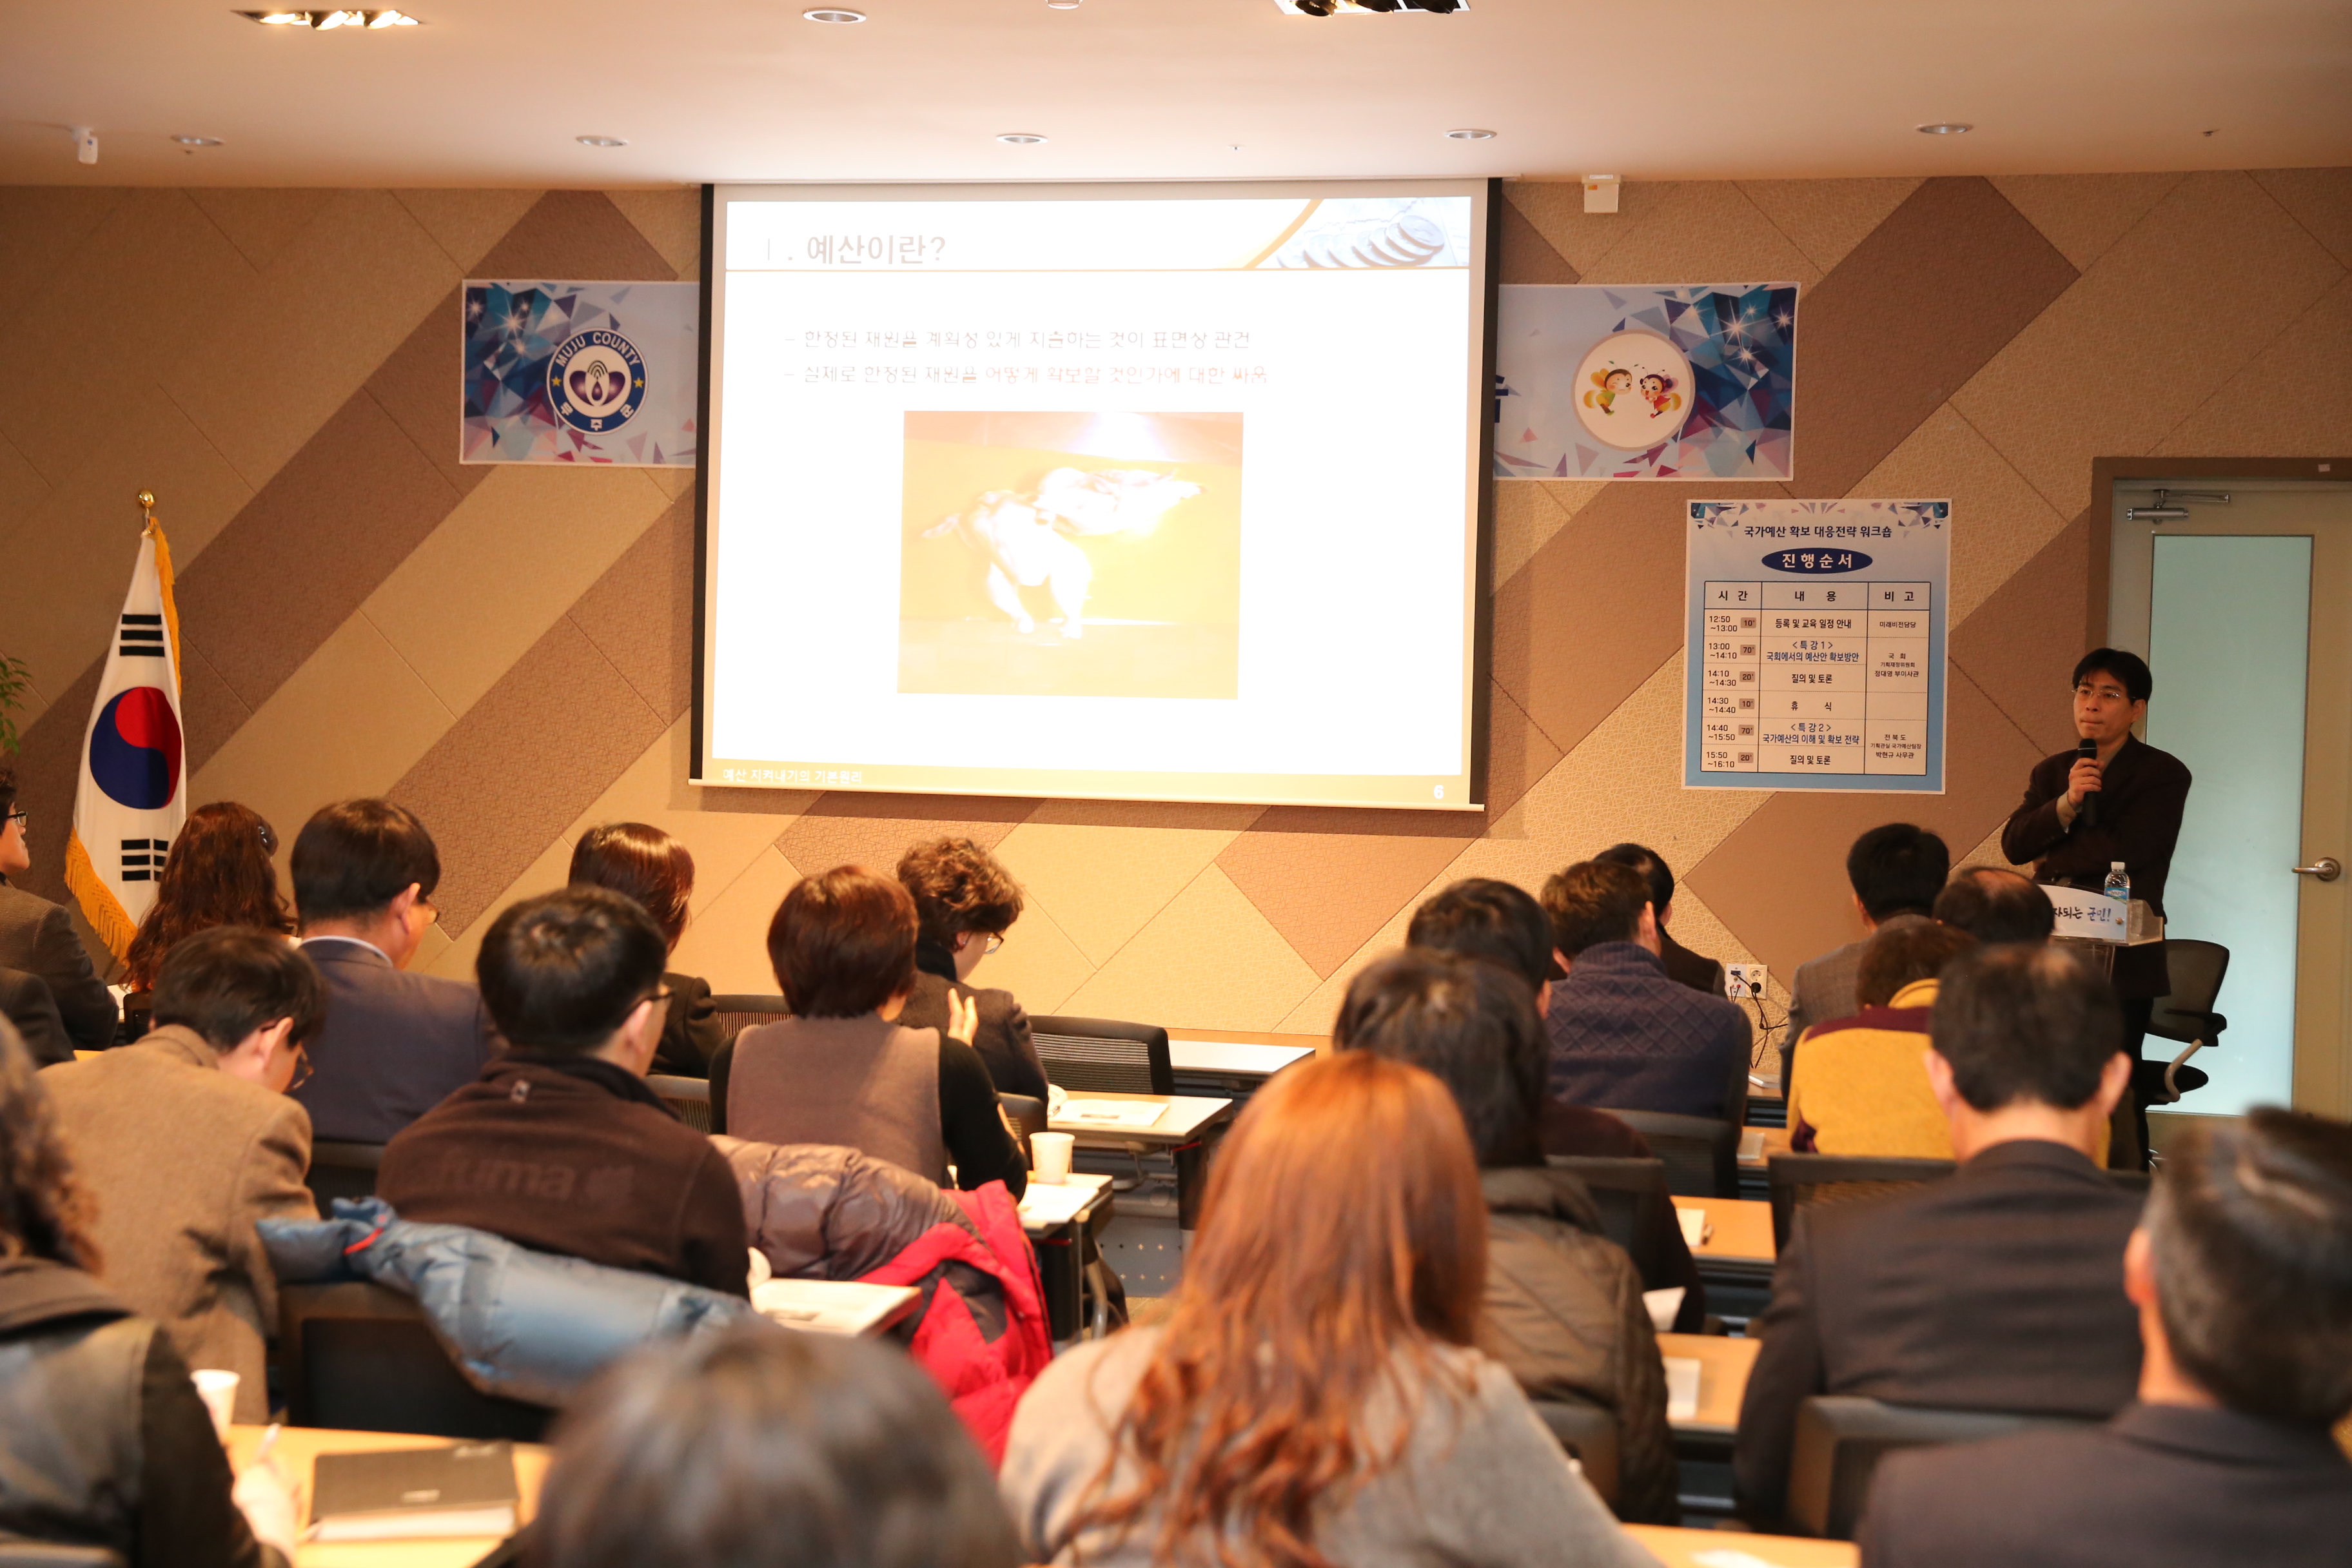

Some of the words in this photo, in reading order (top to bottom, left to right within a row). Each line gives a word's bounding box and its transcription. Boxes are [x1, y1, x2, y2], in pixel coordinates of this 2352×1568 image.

[807, 235, 945, 264] 예산이란?
[986, 331, 1021, 348] 있게
[1110, 331, 1142, 348] 것이
[1152, 331, 1208, 349] 표면상
[556, 335, 586, 367] MUJU
[593, 332, 640, 366] COUNTY
[1744, 526, 1786, 538] 국가예산
[1790, 526, 1810, 538] 확보
[1814, 526, 1857, 538] 대응전략
[1860, 526, 1892, 538] 워크숍
[1776, 619, 1790, 628] 등록
[1793, 620, 1799, 628] 및
[1802, 620, 1817, 628] 교육
[1819, 620, 1834, 628] 일정
[1837, 620, 1852, 629] 안내
[1767, 652, 1803, 661] 국회에서의
[1805, 652, 1827, 662] 예산안
[1830, 652, 1859, 662] 확보방안
[1792, 674, 1806, 683] 질의
[1808, 674, 1816, 683] 및
[1818, 675, 1832, 683] 토론
[1763, 734, 1799, 743] 국가예산의
[1802, 735, 1816, 744] 이해
[1819, 735, 1825, 744] 및
[1828, 735, 1842, 744] 확보
[1845, 736, 1859, 744] 전략
[1790, 756, 1804, 765] 질의
[1807, 756, 1814, 765] 및
[1816, 756, 1830, 765] 토론
[723, 769, 747, 781] 예산
[815, 770, 862, 784] 기본원리
[1434, 785, 1444, 799] 6
[2087, 906, 2111, 921] 군민!
